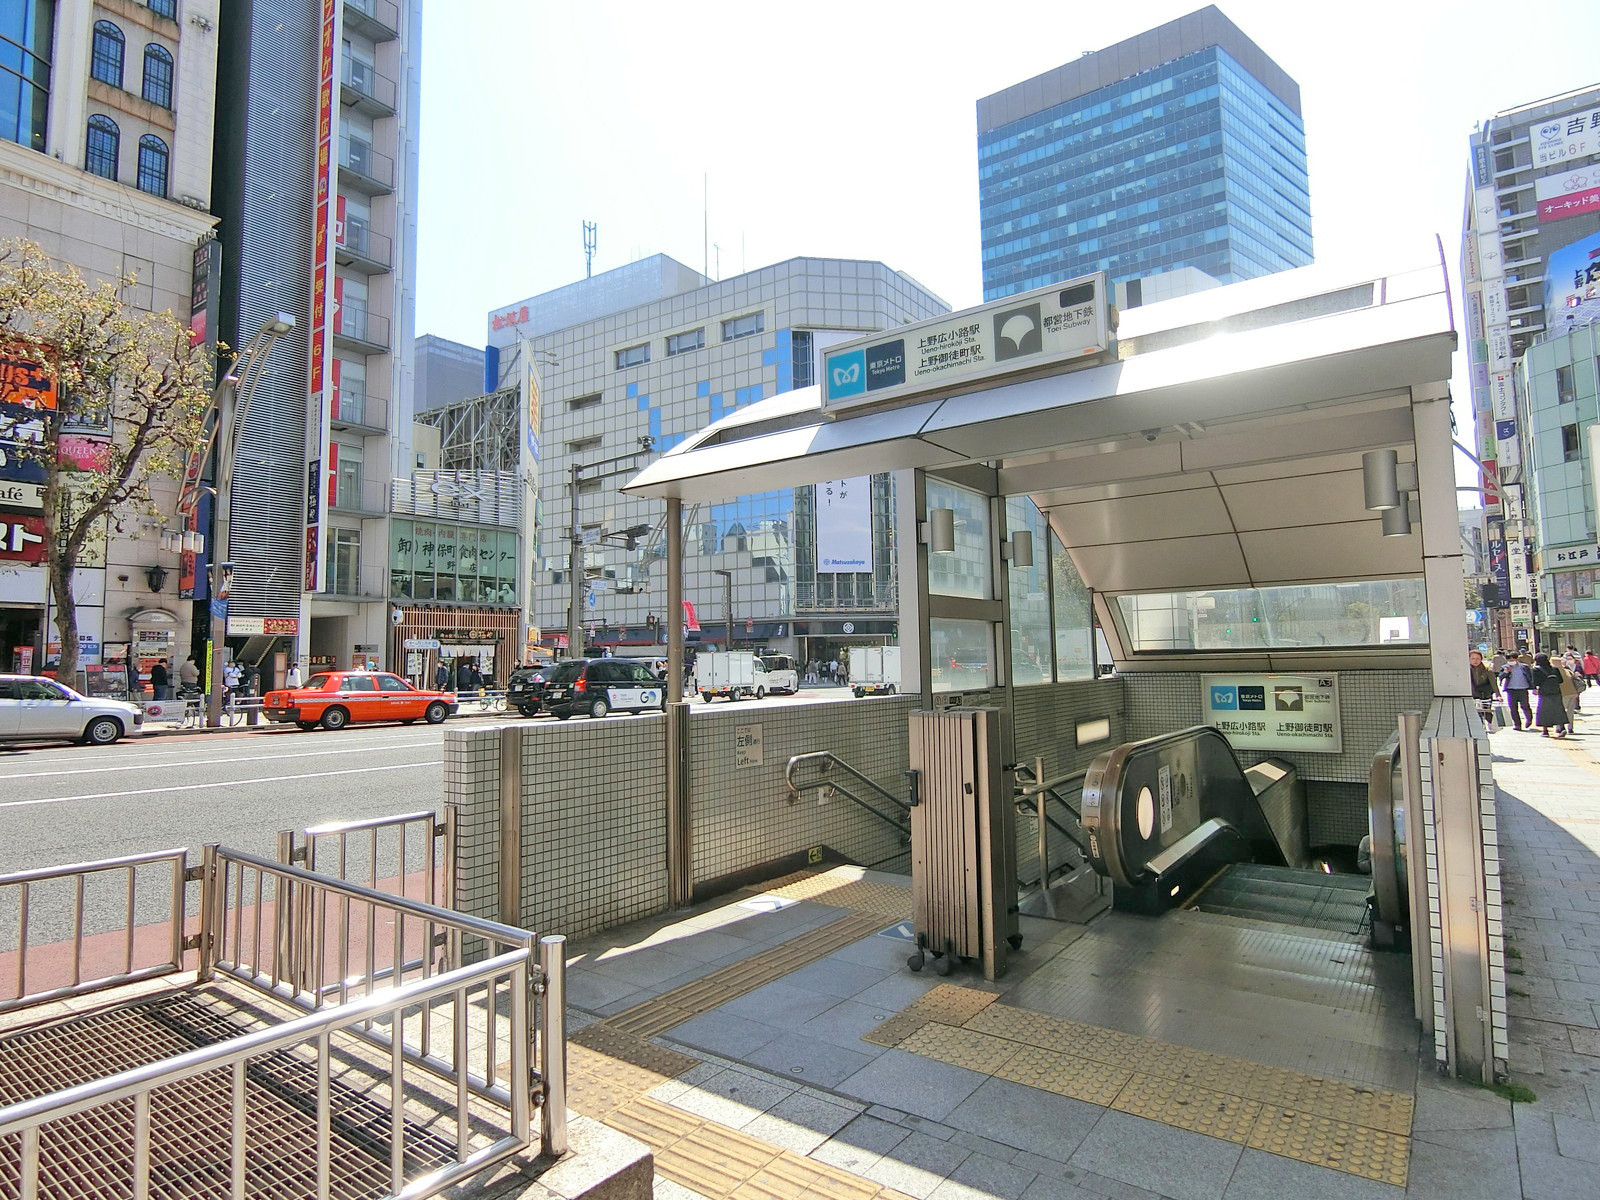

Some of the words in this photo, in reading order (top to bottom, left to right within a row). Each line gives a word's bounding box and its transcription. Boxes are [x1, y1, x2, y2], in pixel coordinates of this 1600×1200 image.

[1043, 305, 1094, 328] 都営地下鉄
[1047, 325, 1062, 333] Toei
[1063, 319, 1091, 330] Subway
[917, 324, 980, 349] 上野広小路駅
[869, 355, 902, 370] 東京メトロ
[918, 344, 982, 369] 上野御徒町駅
[871, 367, 886, 376] Tokyo
[886, 364, 900, 373] Metro
[914, 357, 972, 376] Ueno-okachimachi
[973, 355, 986, 363] Sta.
[1214, 721, 1266, 731] 上野広小路駅
[1276, 722, 1333, 732] 上野御徒町駅
[737, 756, 749, 766] Left
